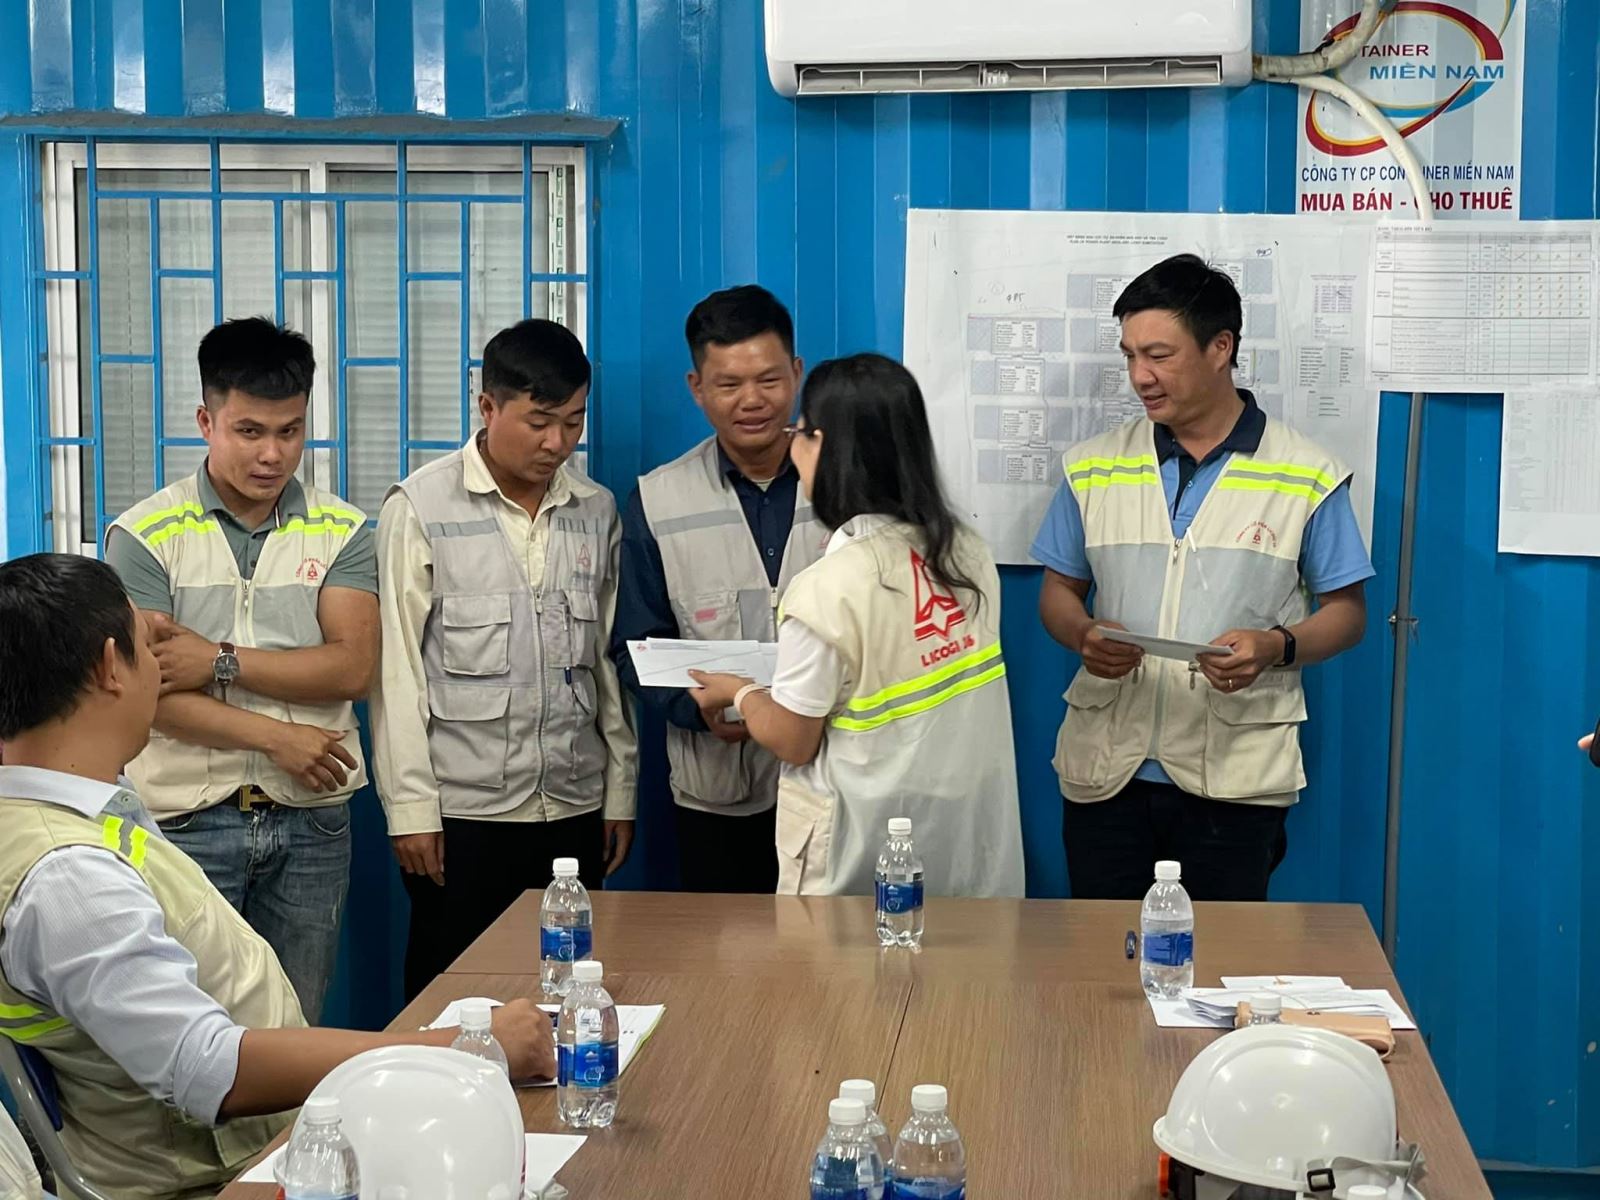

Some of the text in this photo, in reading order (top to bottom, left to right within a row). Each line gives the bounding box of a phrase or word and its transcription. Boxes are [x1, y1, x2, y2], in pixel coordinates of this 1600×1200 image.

[1361, 44, 1430, 58] TAINER
[1446, 65, 1504, 79] NAM
[1302, 164, 1338, 182] CÔNG
[1342, 167, 1357, 181] TY
[1361, 166, 1376, 181] CP
[1380, 165, 1450, 180] CONINER
[1487, 165, 1514, 180] NAM
[1301, 193, 1345, 212] MUA
[1353, 187, 1392, 211] BÁN
[1459, 186, 1513, 210] THUÊ
